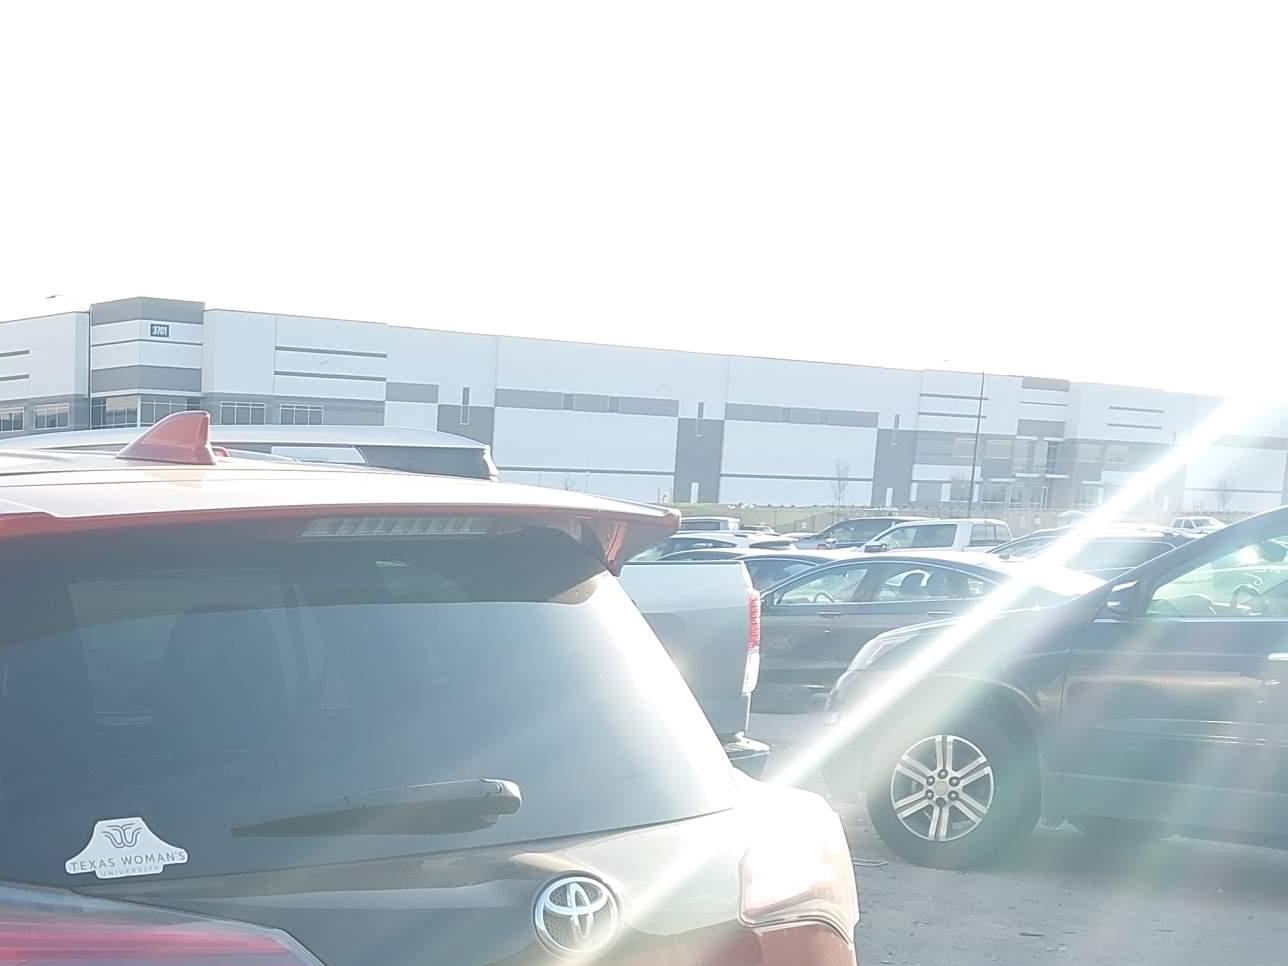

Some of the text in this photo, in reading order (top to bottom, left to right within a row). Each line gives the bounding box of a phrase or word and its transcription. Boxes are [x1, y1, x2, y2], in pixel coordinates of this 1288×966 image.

[152, 325, 168, 336] 3701
[70, 851, 186, 872] TEXAS WOMAN'S
